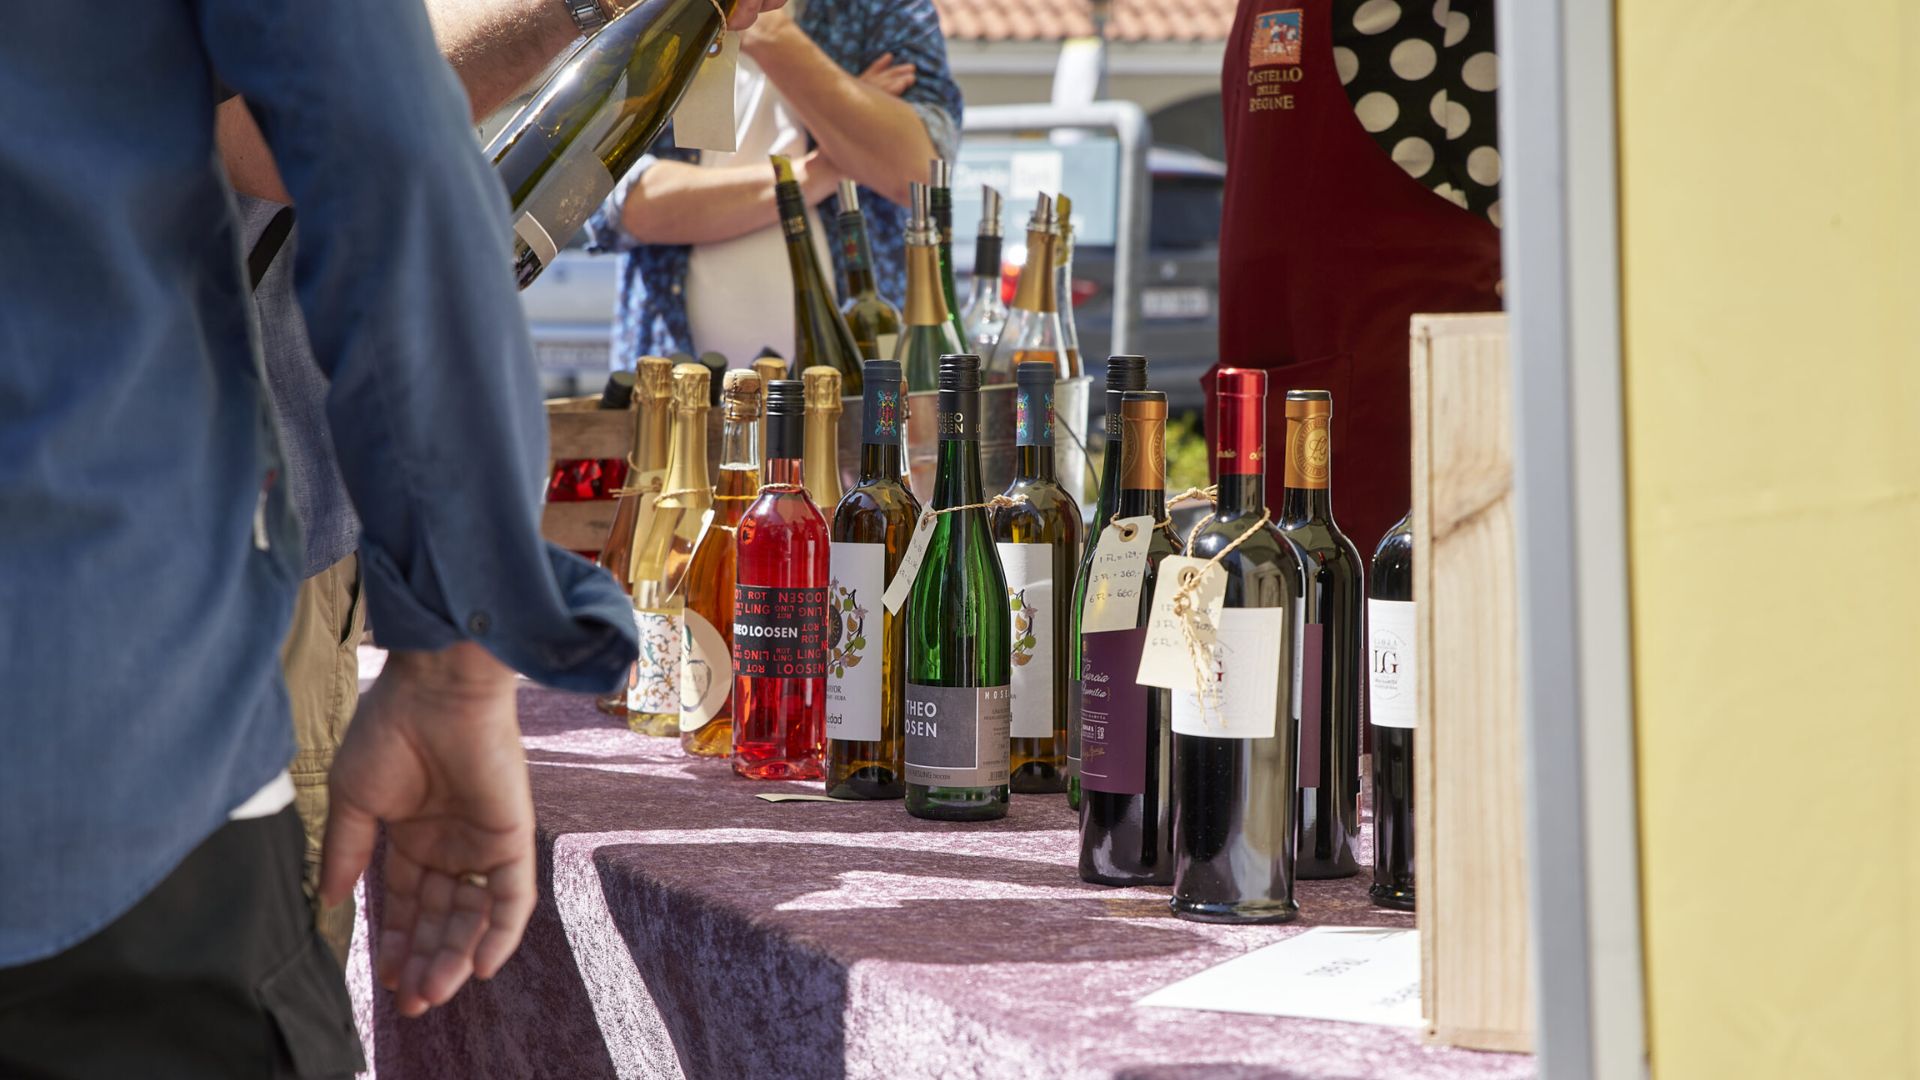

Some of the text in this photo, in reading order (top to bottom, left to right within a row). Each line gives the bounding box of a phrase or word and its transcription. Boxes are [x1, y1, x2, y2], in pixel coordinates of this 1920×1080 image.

[1248, 67, 1302, 86] CASTELLO
[1256, 85, 1280, 96] DELLE
[1249, 96, 1294, 112] REGINE
[748, 591, 767, 600] ROT
[745, 604, 770, 614] LING
[799, 607, 822, 616] LING
[749, 625, 798, 638] LOOSEN
[802, 624, 819, 632] ROT
[801, 635, 819, 643] ROT
[744, 650, 769, 660] LING
[797, 649, 821, 659] LING
[1374, 650, 1398, 674] LG
[746, 664, 765, 673] ROT
[777, 663, 825, 674] LOOSEN
[984, 690, 1009, 700] MOSE
[906, 700, 937, 718] THEO
